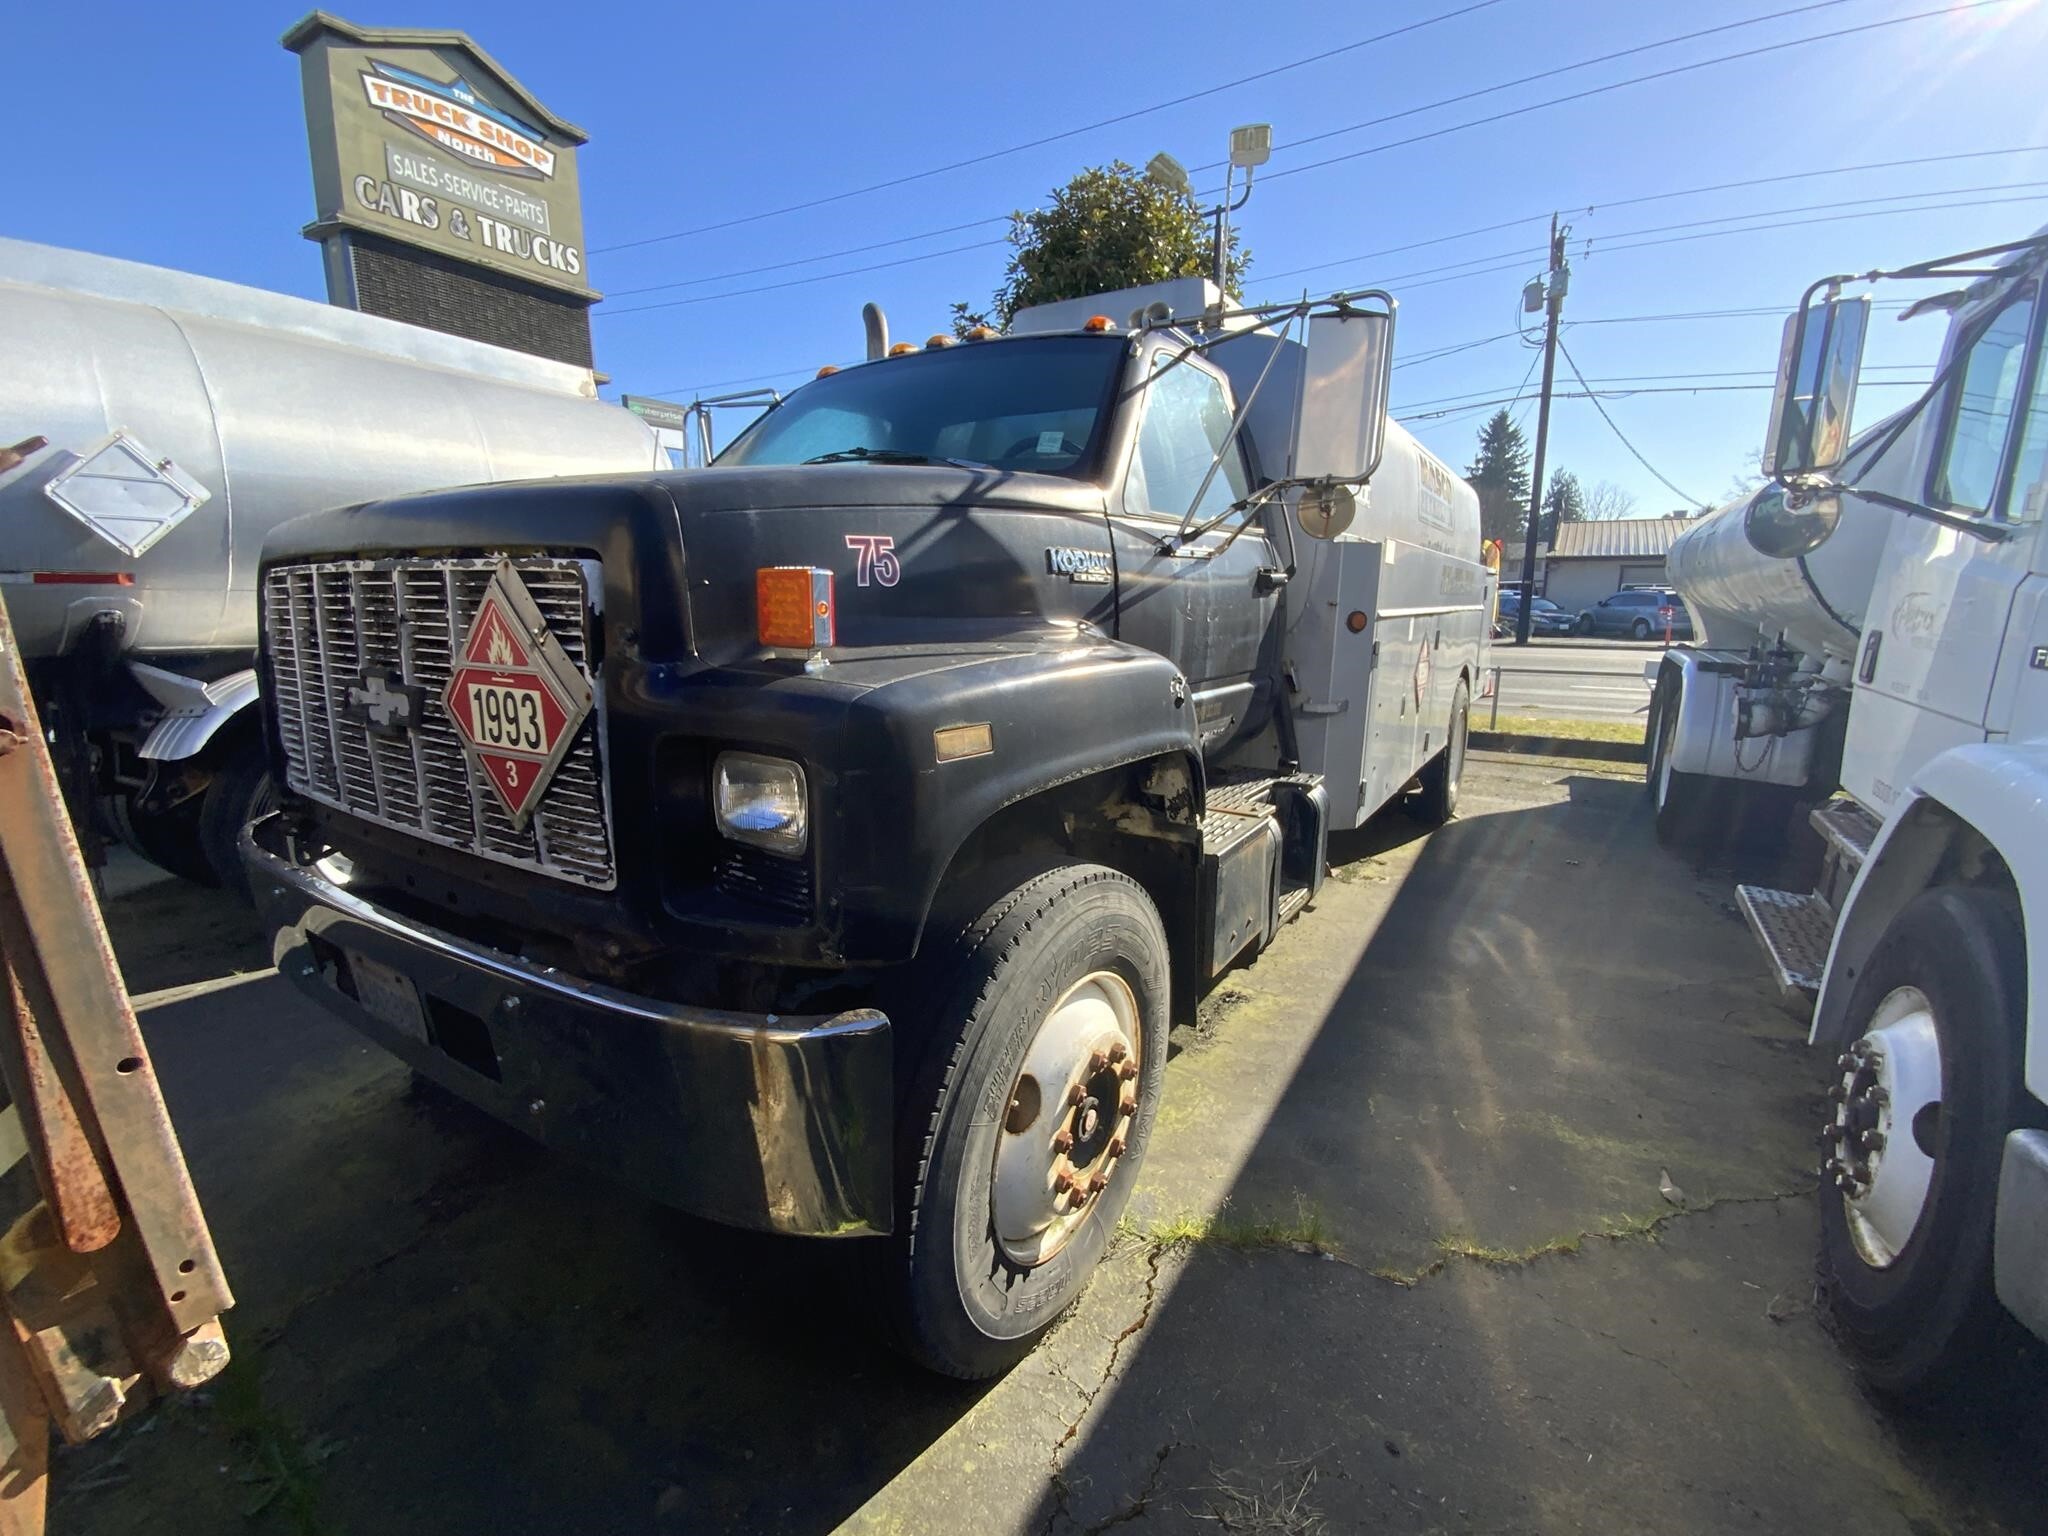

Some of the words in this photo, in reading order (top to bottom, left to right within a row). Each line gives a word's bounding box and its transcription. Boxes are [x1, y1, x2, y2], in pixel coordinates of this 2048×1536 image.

[452, 88, 476, 105] THE
[371, 81, 472, 131] TRUCK
[478, 120, 550, 166] SHOP
[436, 129, 497, 164] North
[354, 175, 440, 230] CARS
[450, 208, 473, 242] &
[476, 214, 581, 276] TRUCKS
[845, 535, 901, 588] 75
[473, 687, 542, 750] 1993
[505, 760, 519, 788] 3
